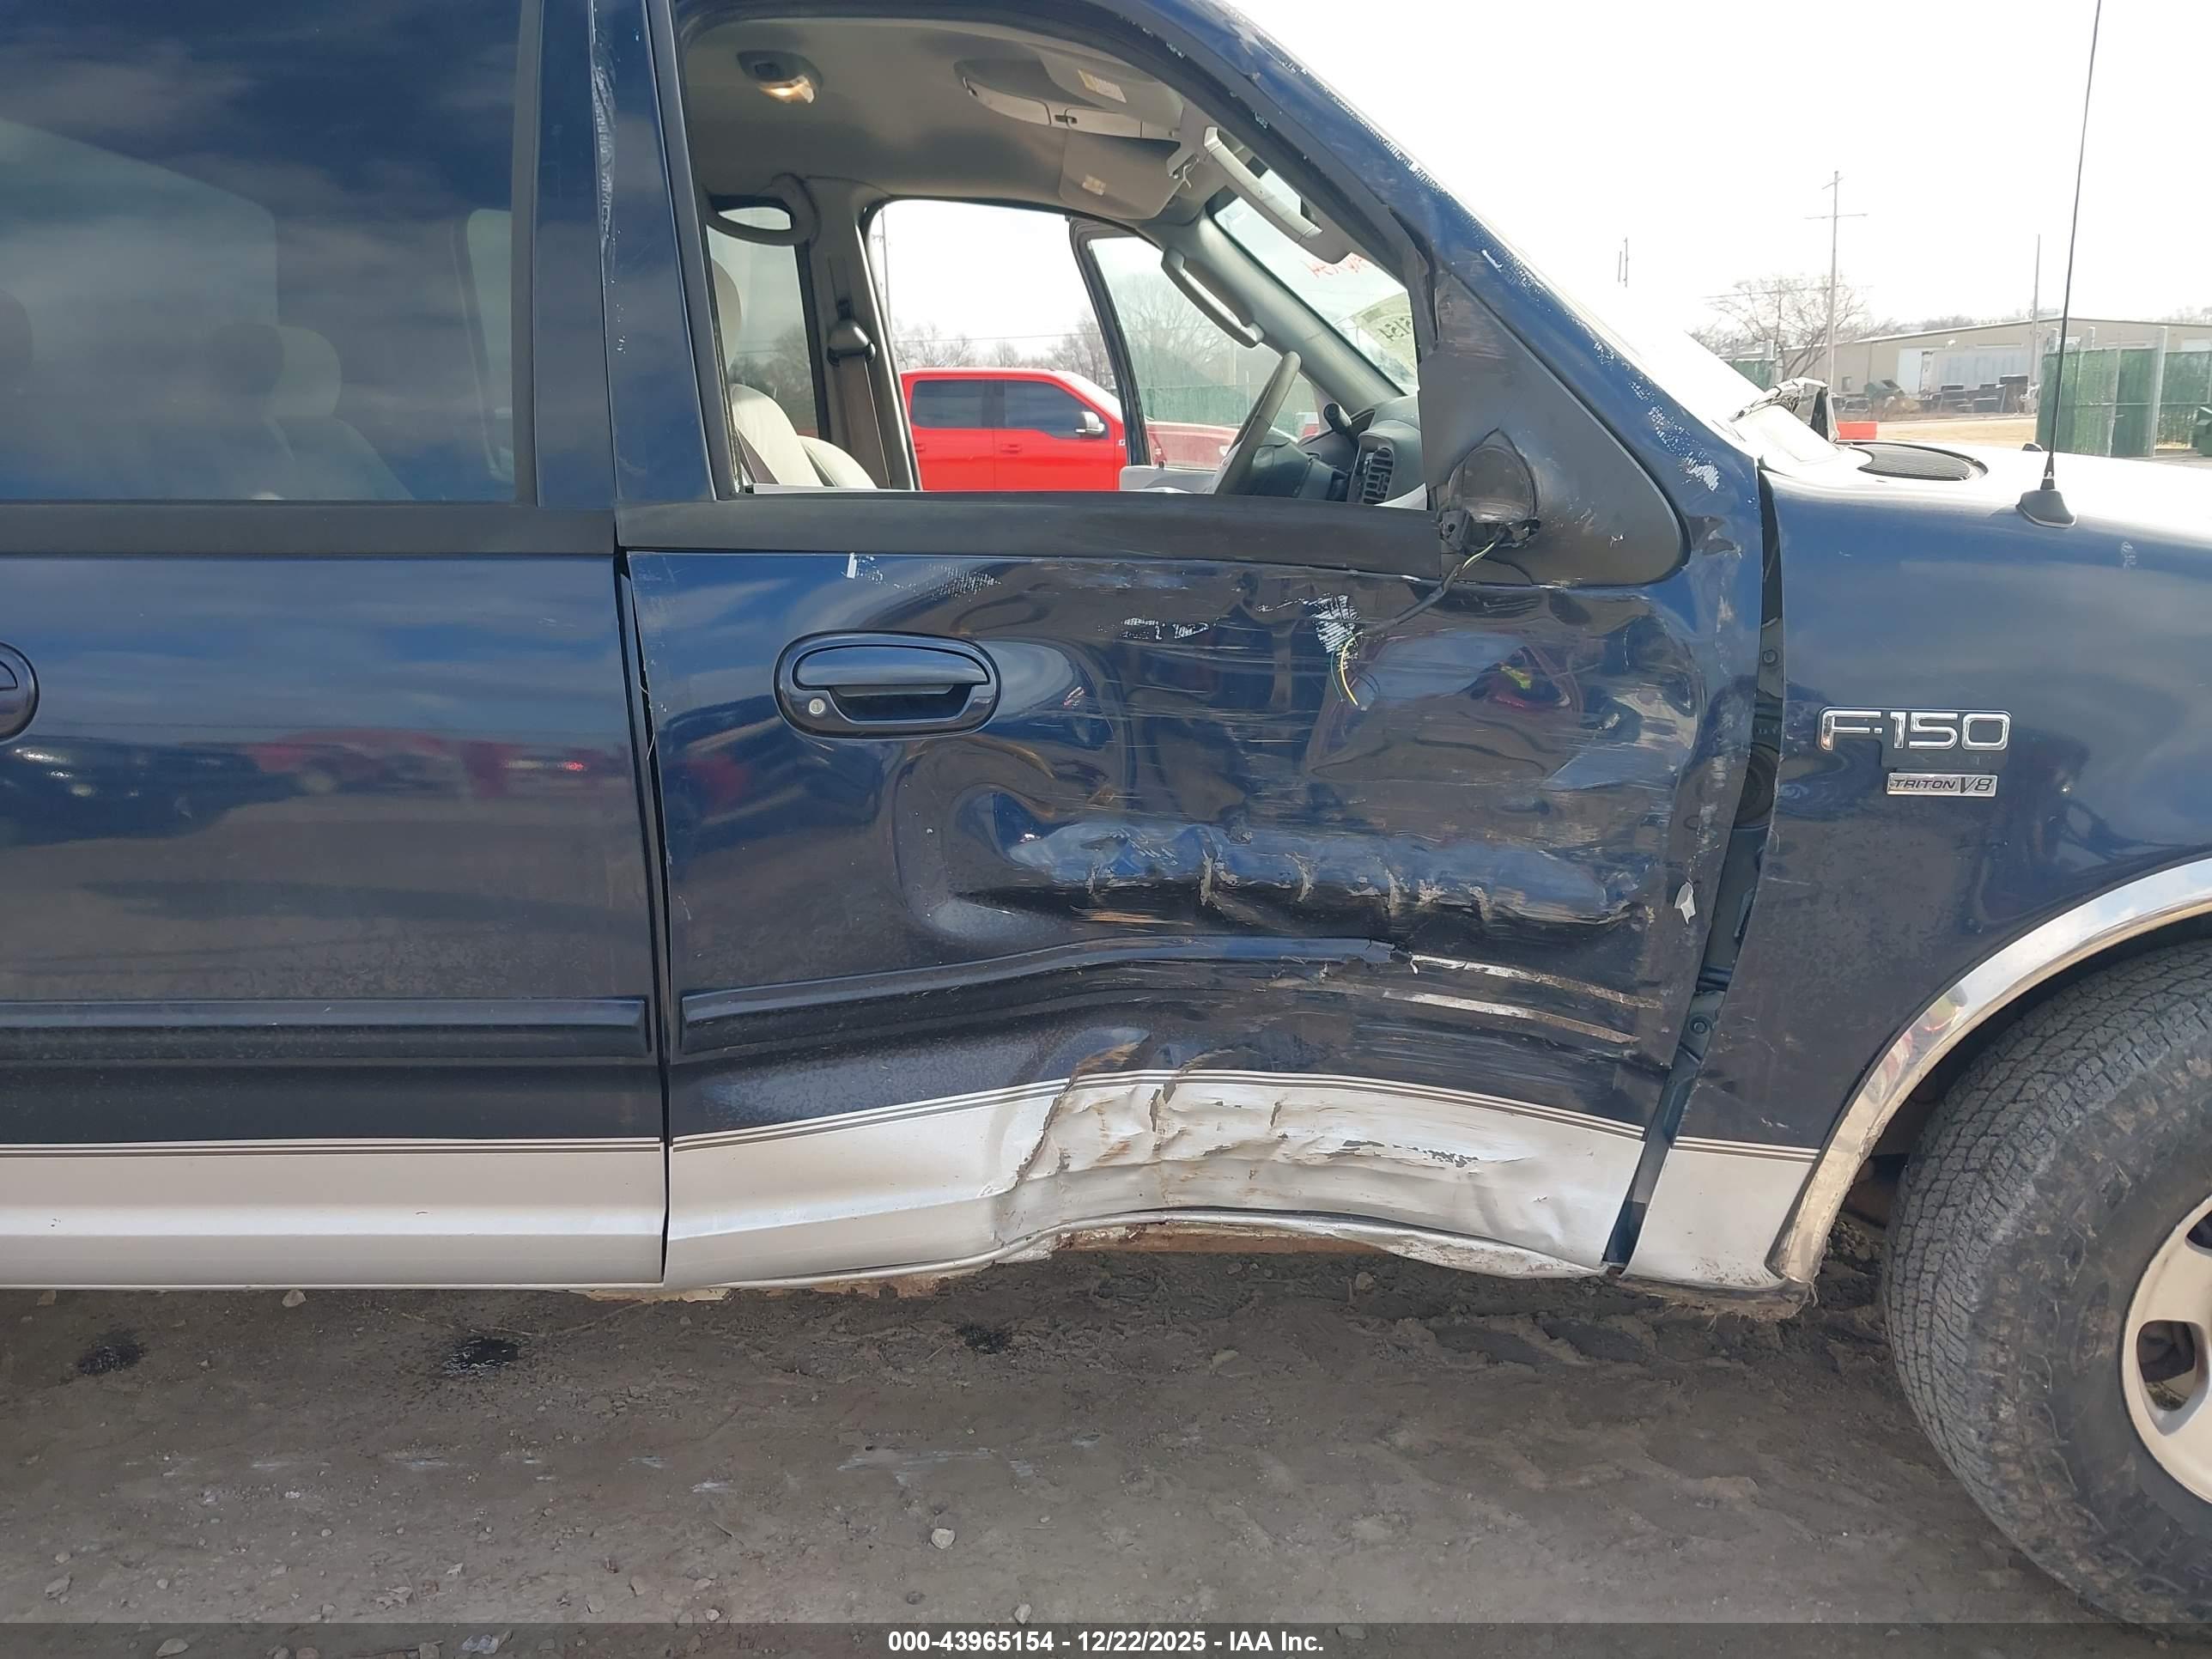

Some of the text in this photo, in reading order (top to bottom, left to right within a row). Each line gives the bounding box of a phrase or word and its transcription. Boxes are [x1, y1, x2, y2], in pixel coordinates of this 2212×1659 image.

[1820, 710, 2011, 750] F-150
[1893, 776, 1993, 793] TRITON V8
